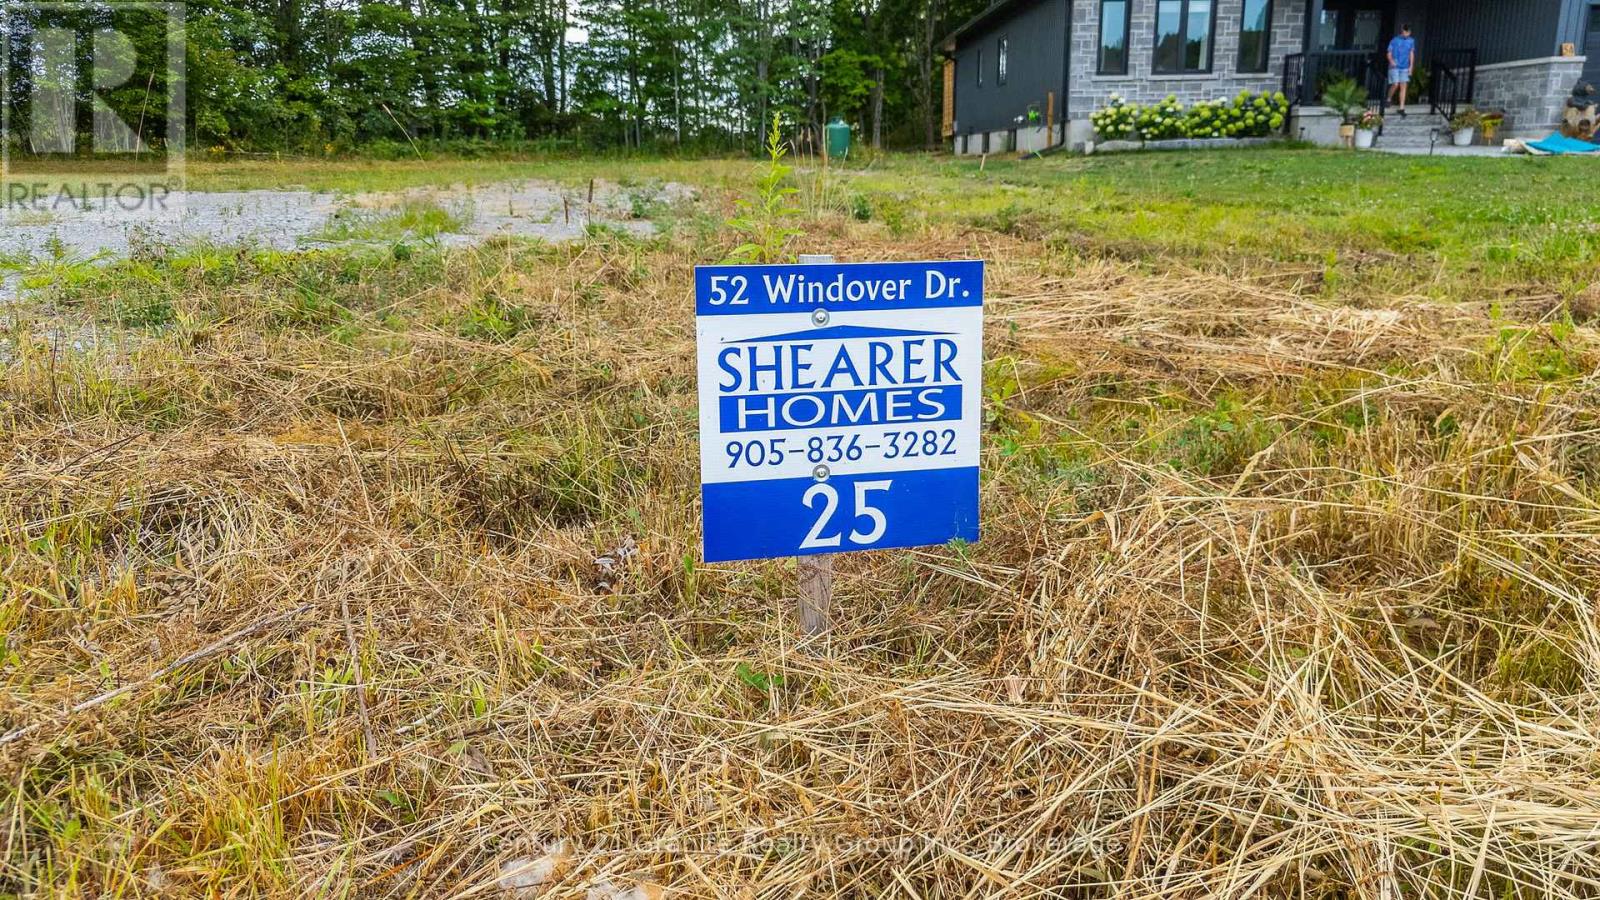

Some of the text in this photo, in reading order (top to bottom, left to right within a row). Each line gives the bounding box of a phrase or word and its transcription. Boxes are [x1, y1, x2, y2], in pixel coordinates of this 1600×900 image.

[709, 270, 970, 305] 52 Windover Dr.
[717, 338, 962, 393] SHEARER
[737, 388, 946, 430] HOMES
[725, 428, 957, 468] 905-836-3282
[798, 479, 893, 549] 25
